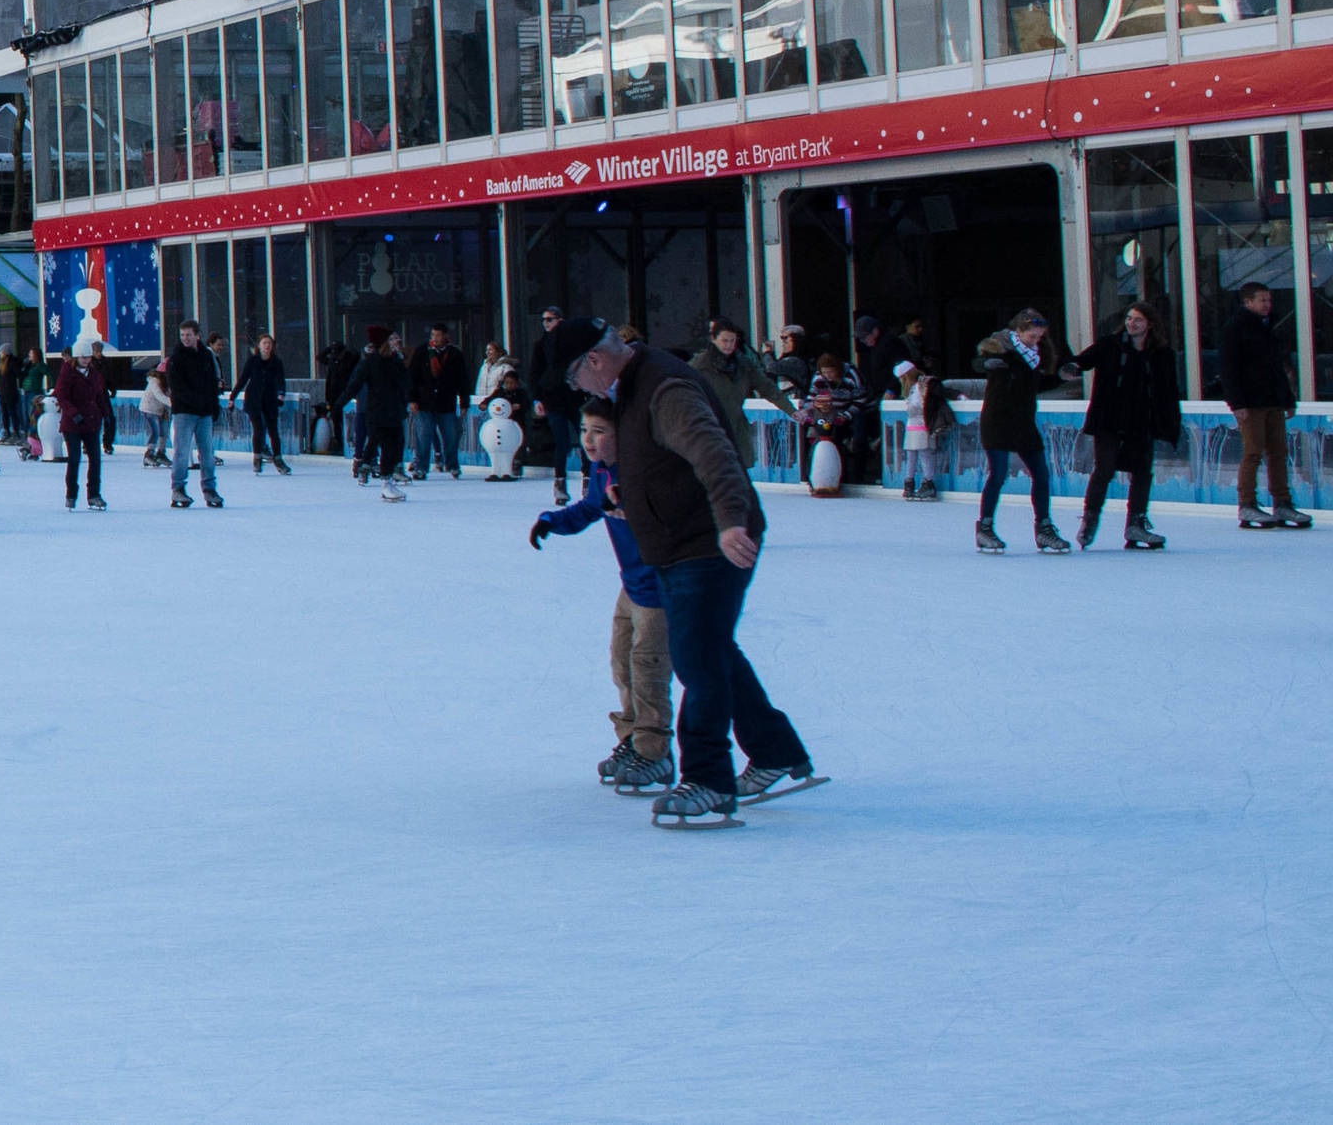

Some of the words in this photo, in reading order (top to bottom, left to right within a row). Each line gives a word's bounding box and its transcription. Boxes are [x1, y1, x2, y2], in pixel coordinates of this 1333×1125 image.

[486, 178, 510, 196] Bank
[511, 175, 522, 192] of
[522, 172, 564, 191] America
[596, 155, 660, 183] Winter
[661, 145, 728, 177] Village
[735, 150, 750, 167] at
[752, 143, 797, 168] Bryant
[799, 135, 831, 159] Park
